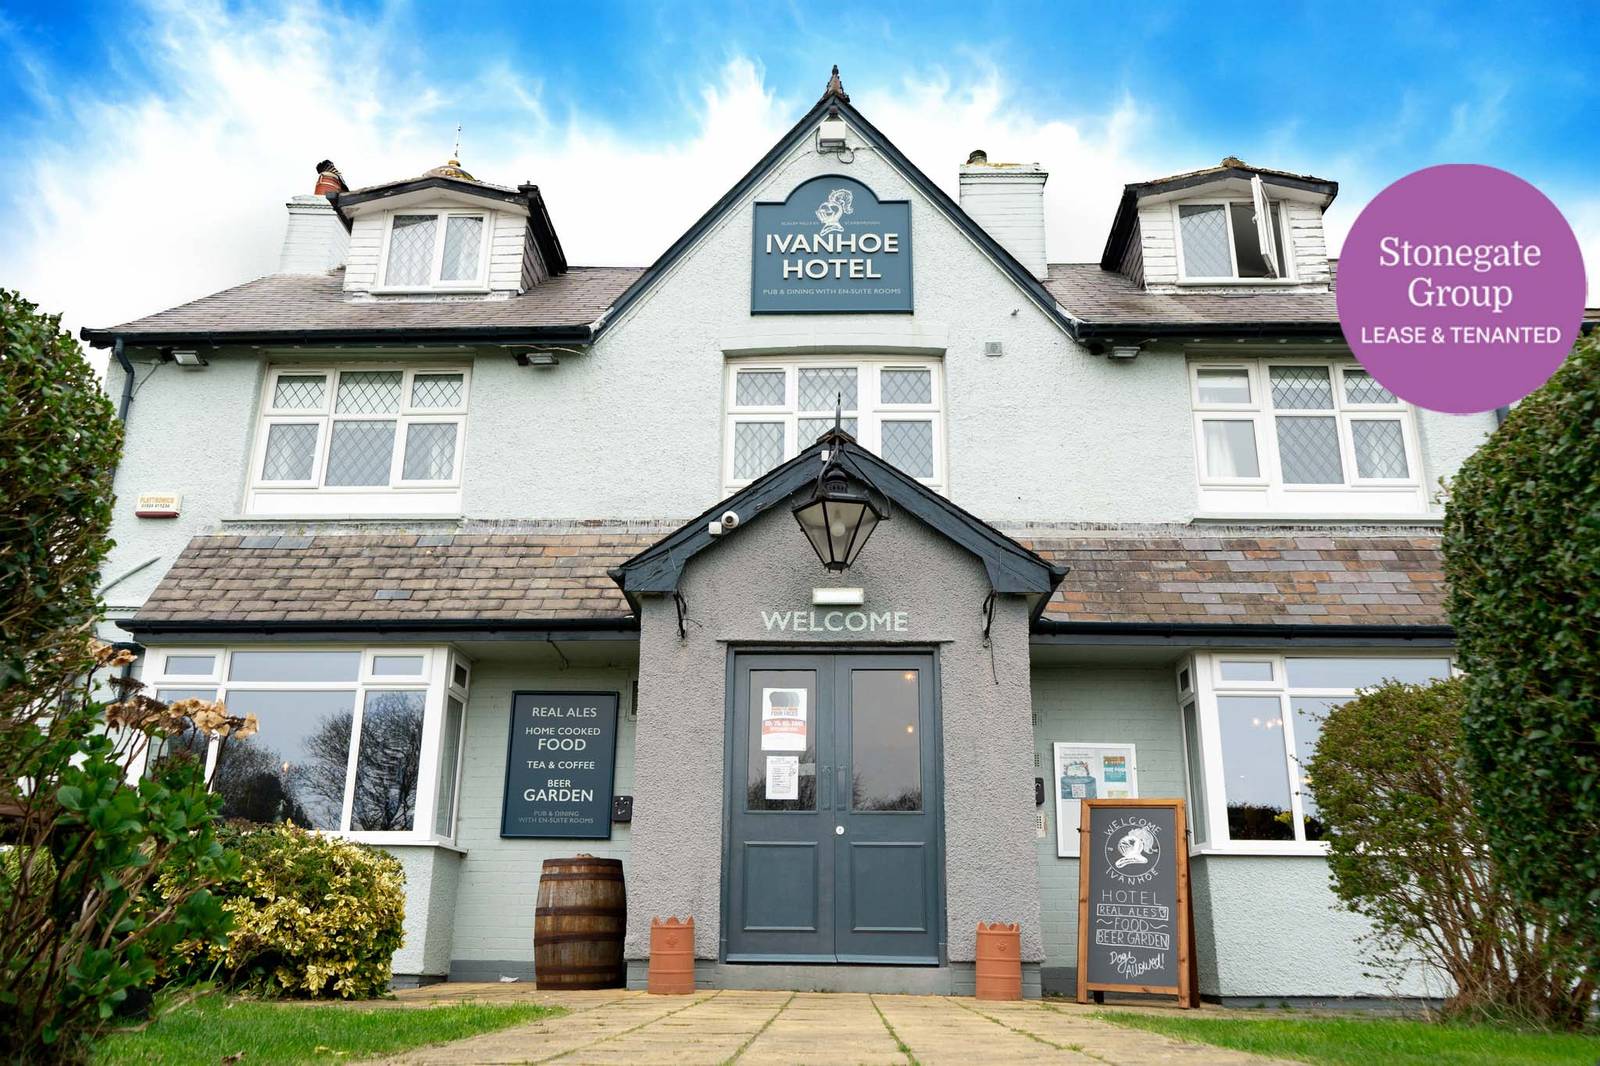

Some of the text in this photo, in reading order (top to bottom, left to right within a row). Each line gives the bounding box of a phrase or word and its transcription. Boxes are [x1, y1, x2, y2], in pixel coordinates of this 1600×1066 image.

[766, 232, 899, 253] IVANHOE
[783, 258, 881, 279] HOTEL
[763, 288, 777, 296] PUB
[761, 611, 908, 631] WELCOME
[532, 707, 597, 718] REAL ALES
[525, 727, 600, 736] HOME COOKED
[538, 739, 586, 751] FOOD
[527, 761, 595, 769] TEA & COFFEE
[547, 779, 571, 788] BEER
[523, 789, 594, 802] GARDEN
[1104, 816, 1163, 836] WELCOME
[1105, 866, 1159, 885] IVANHOE
[1102, 889, 1162, 906] HOTEL
[1100, 905, 1157, 918] REAL ALES
[1114, 917, 1149, 932] FOOD
[1096, 929, 1168, 948] BEER GARDEN
